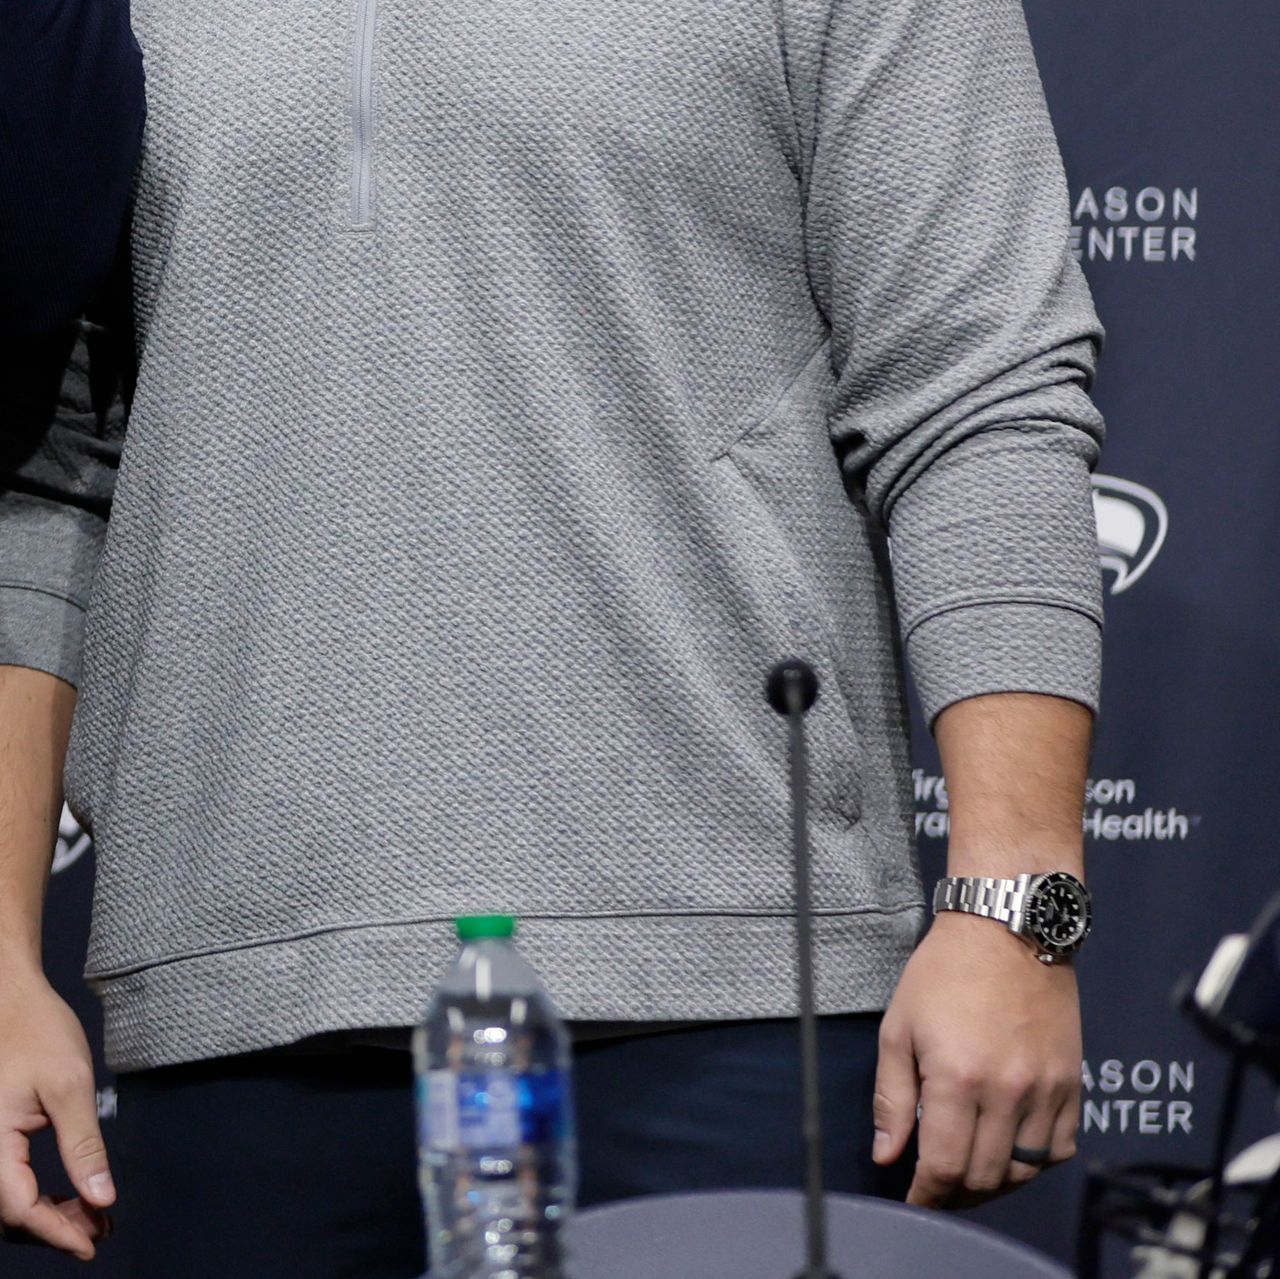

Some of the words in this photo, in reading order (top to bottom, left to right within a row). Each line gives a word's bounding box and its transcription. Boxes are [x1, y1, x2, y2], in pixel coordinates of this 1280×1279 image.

[1073, 186, 1198, 222] ASON
[1082, 807, 1190, 840] Health
[1083, 1099, 1193, 1134] NTER
